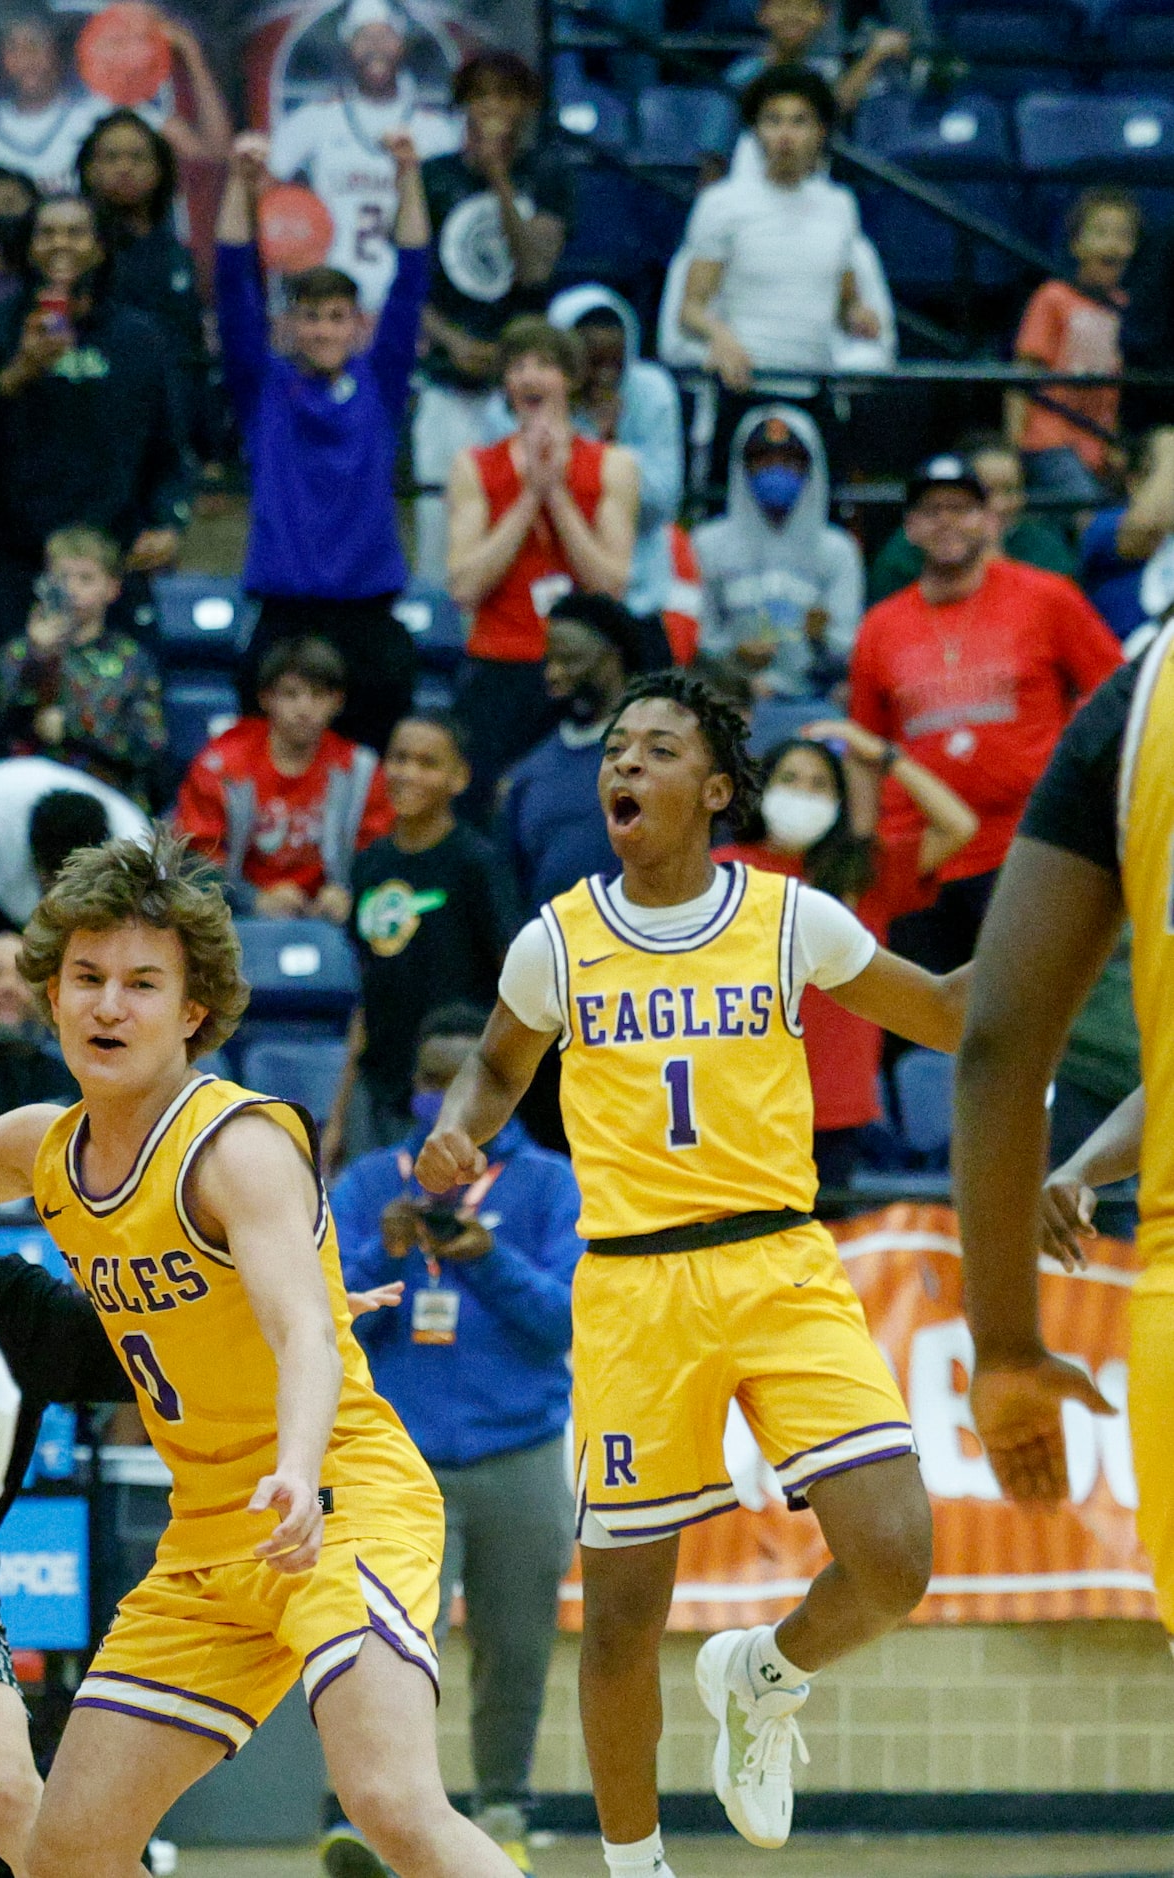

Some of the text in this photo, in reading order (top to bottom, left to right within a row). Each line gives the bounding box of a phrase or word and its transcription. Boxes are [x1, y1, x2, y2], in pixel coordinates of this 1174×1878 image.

[576, 985, 773, 1046] EAGLES
[663, 1059, 697, 1147] 1
[61, 1249, 210, 1315] GLES
[119, 1333, 183, 1423] 0
[602, 1433, 638, 1487] R
